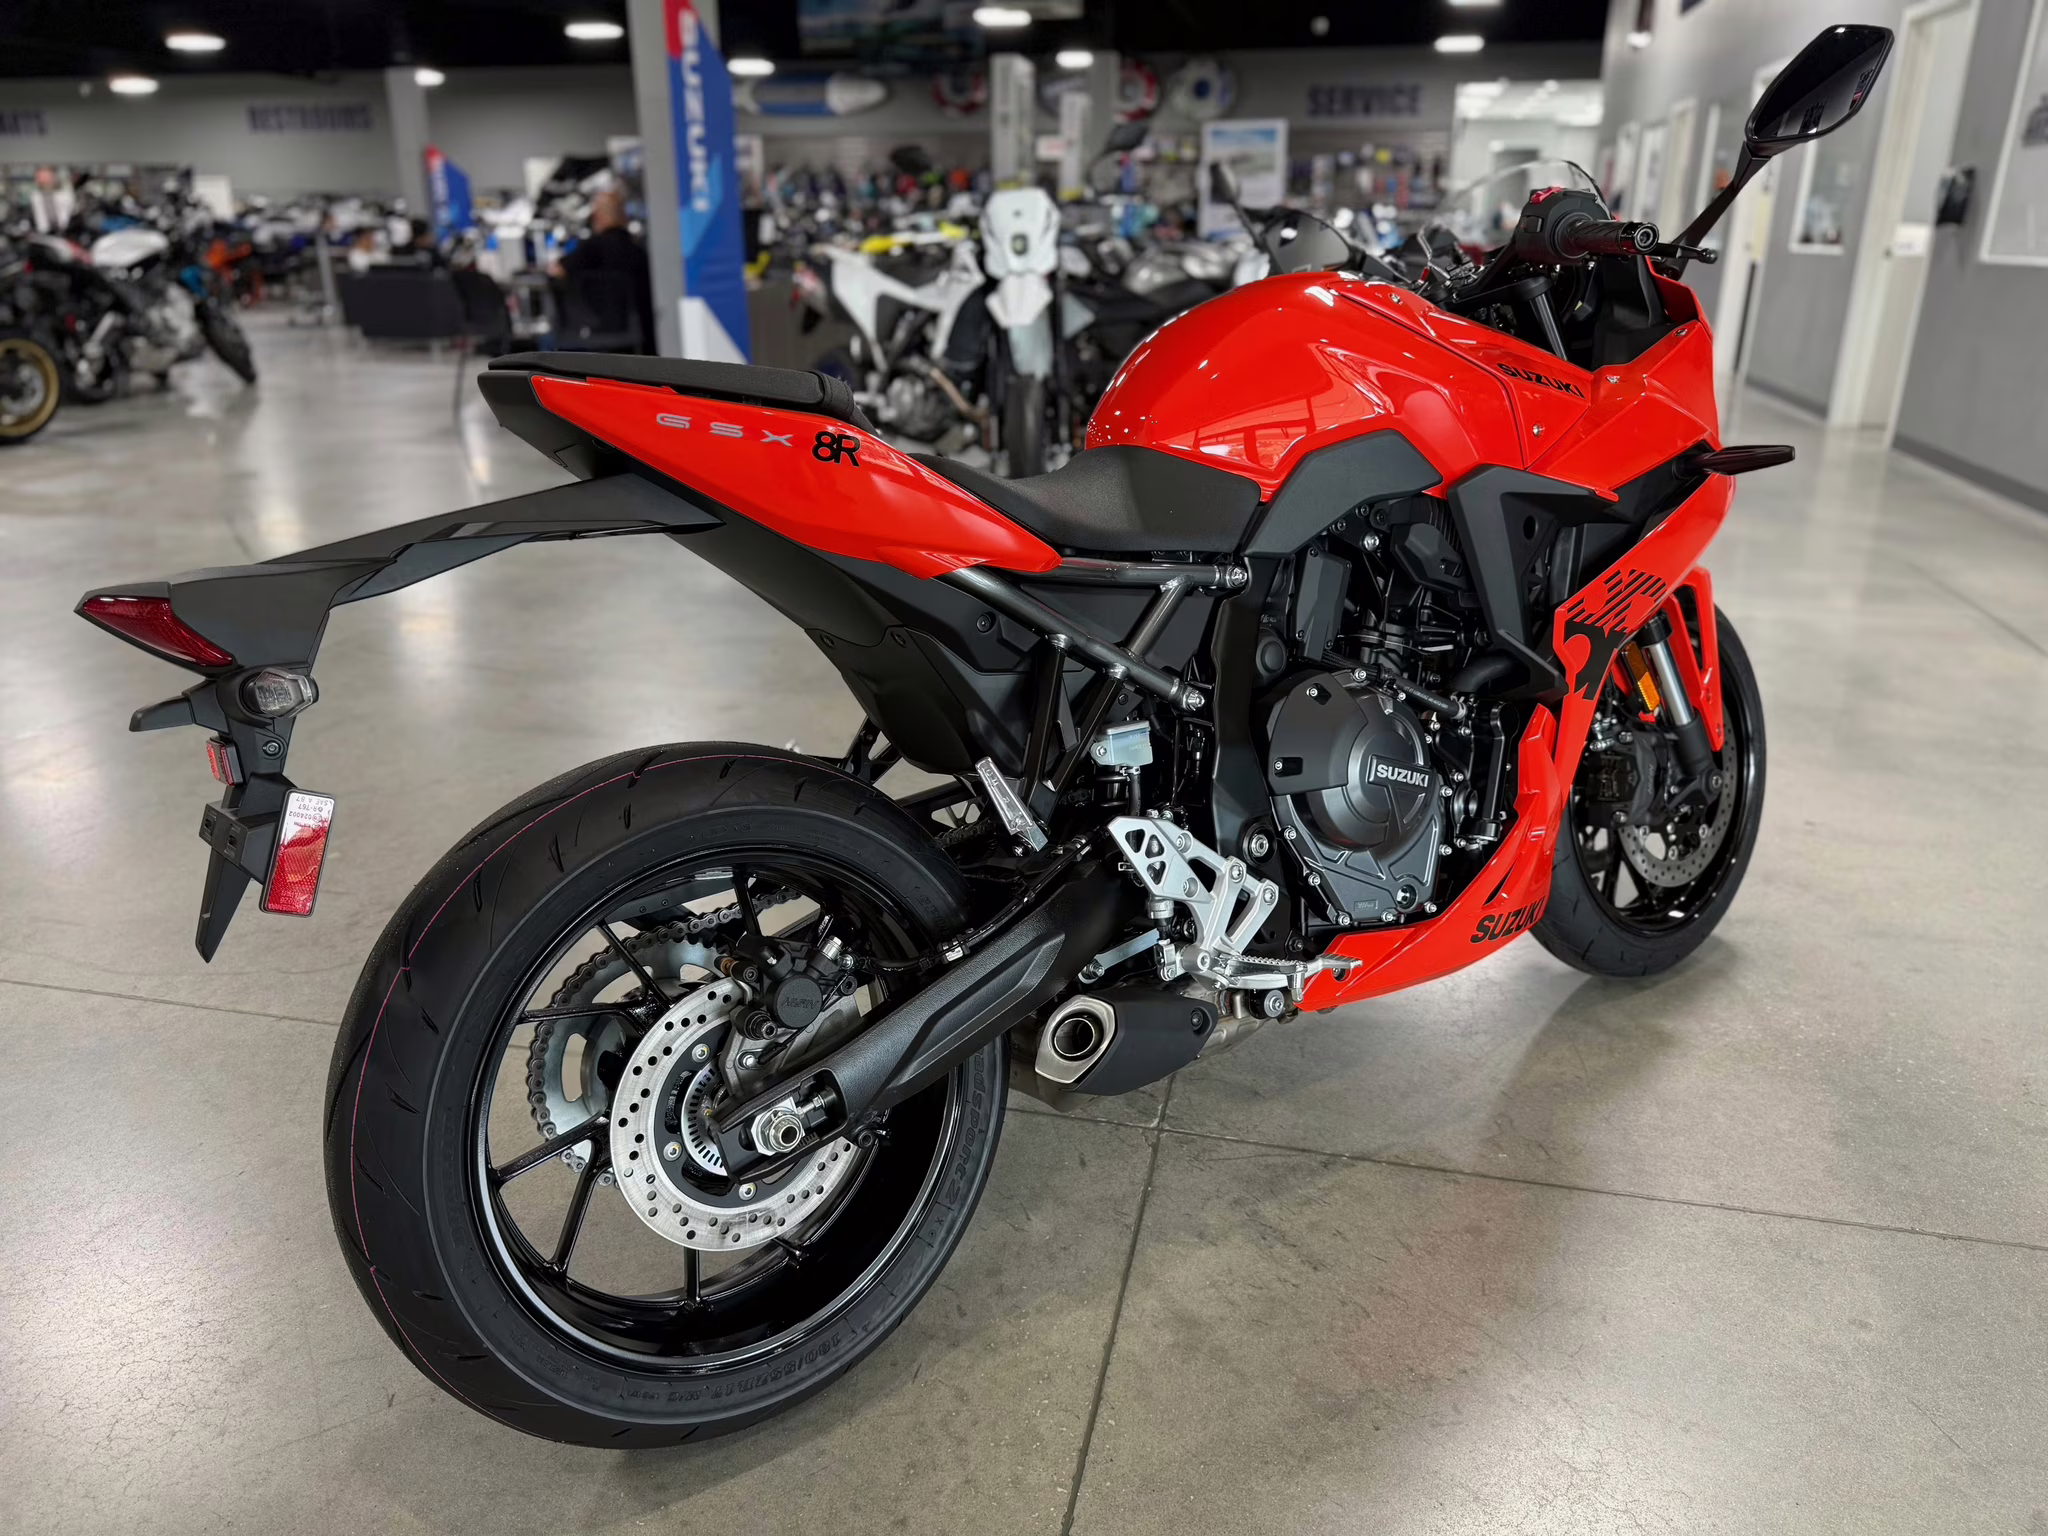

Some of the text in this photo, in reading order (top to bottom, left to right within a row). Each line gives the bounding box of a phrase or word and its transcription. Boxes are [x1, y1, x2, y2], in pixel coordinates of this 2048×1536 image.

[678, 8, 710, 212] SUZUKI
[1308, 84, 1421, 117] SERVICE
[1497, 363, 1586, 399] SUZUKI
[812, 431, 861, 467] 8R
[1376, 764, 1429, 787] SUZUKI
[1470, 896, 1546, 943] SUZUKI
